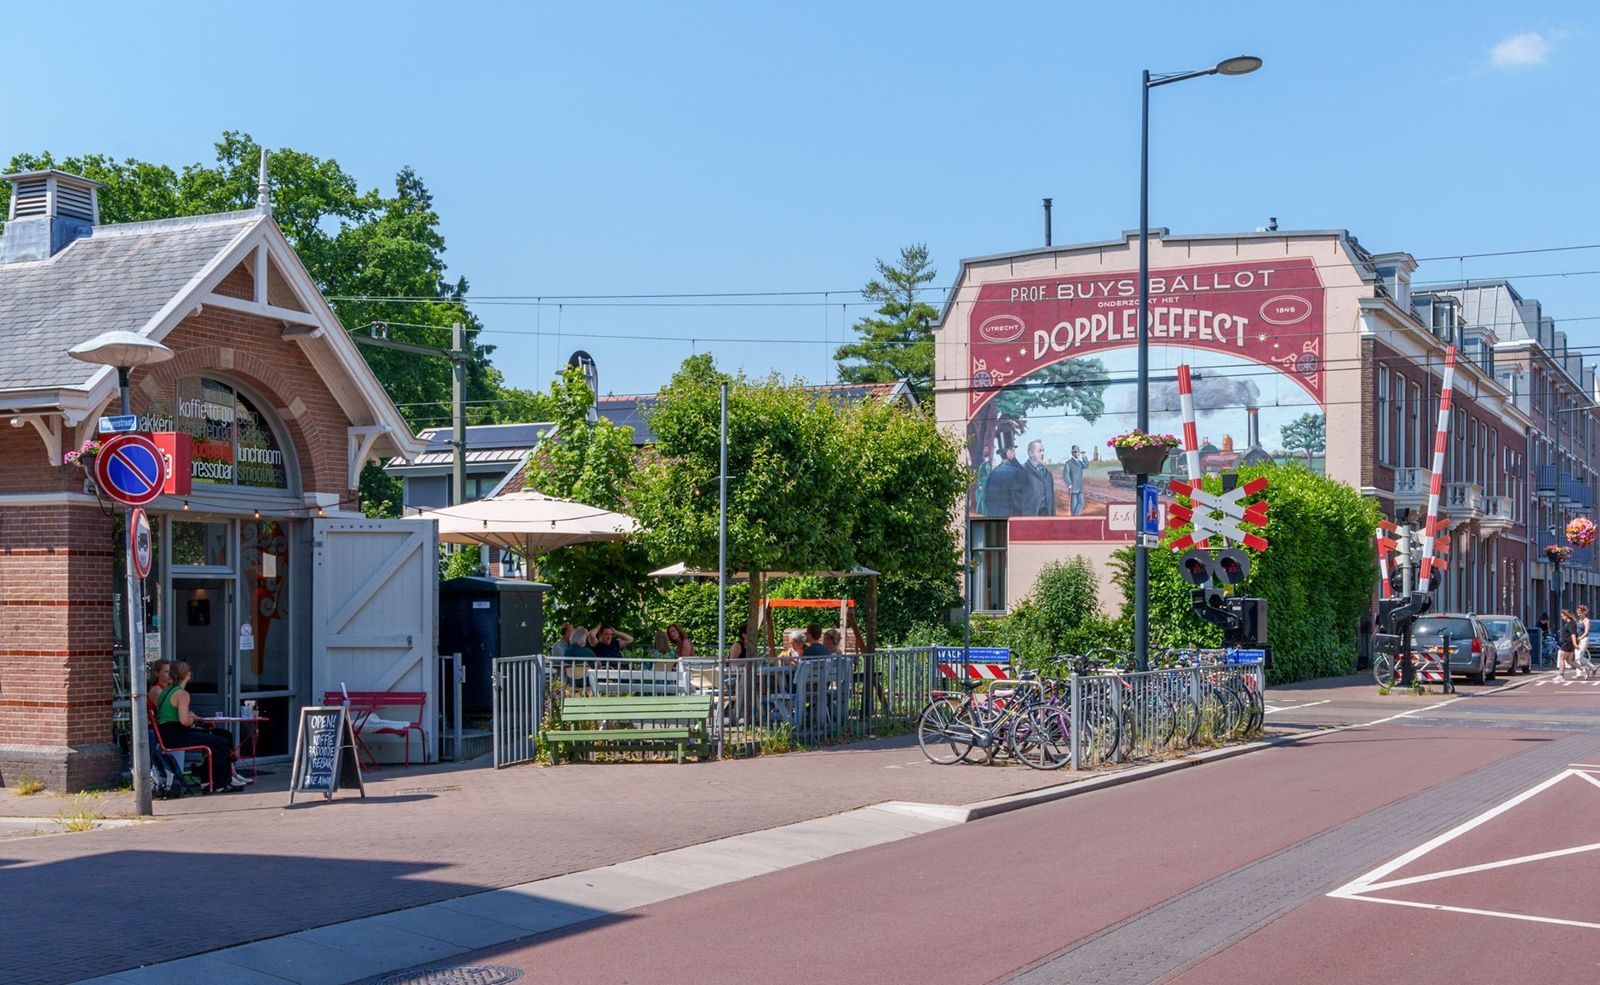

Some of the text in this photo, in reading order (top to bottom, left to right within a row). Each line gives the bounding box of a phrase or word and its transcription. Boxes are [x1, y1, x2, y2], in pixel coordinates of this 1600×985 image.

[1010, 269, 1275, 303] PROF. BUYS BALLOT
[1097, 296, 1180, 308] ONDERZOKT HET
[1274, 306, 1296, 314] 1845
[984, 324, 1019, 333] UTRECHT
[178, 396, 234, 427] koffie to go
[237, 442, 283, 465] lunchroom
[311, 715, 337, 729] OPEN!
[312, 732, 336, 747] KOFFIE
